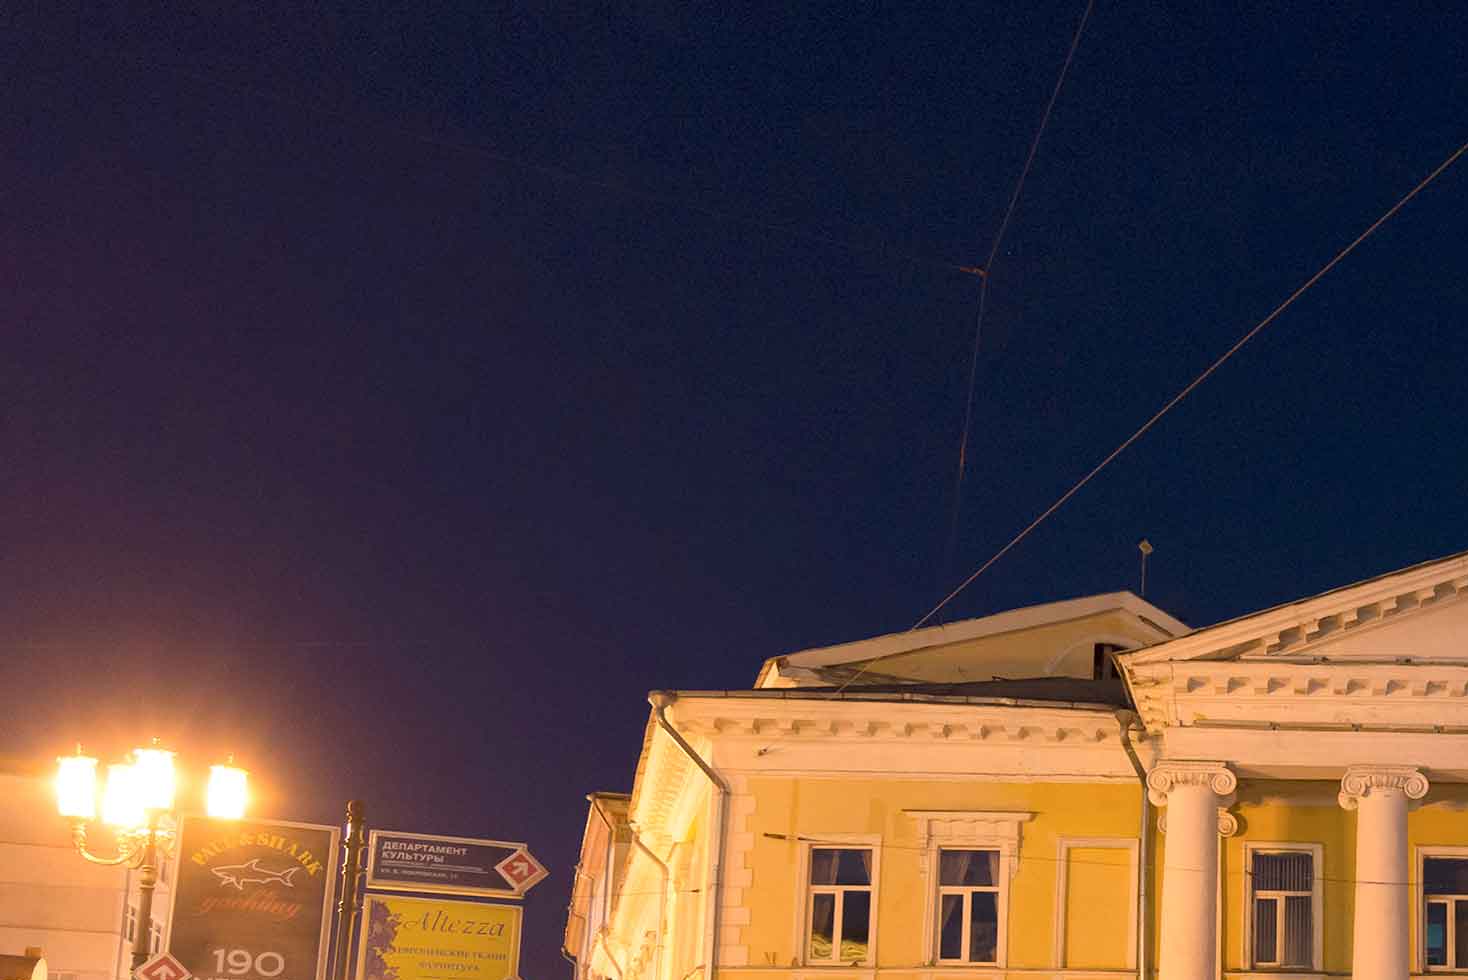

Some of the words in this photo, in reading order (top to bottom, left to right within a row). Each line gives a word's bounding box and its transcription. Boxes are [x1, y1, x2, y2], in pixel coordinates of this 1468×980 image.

[381, 850, 445, 863] КУЛЬТУРЫ
[382, 840, 468, 856] ДЕПАРТАМЕНТ
[401, 910, 505, 937] Altezza
[213, 948, 285, 977] 190
